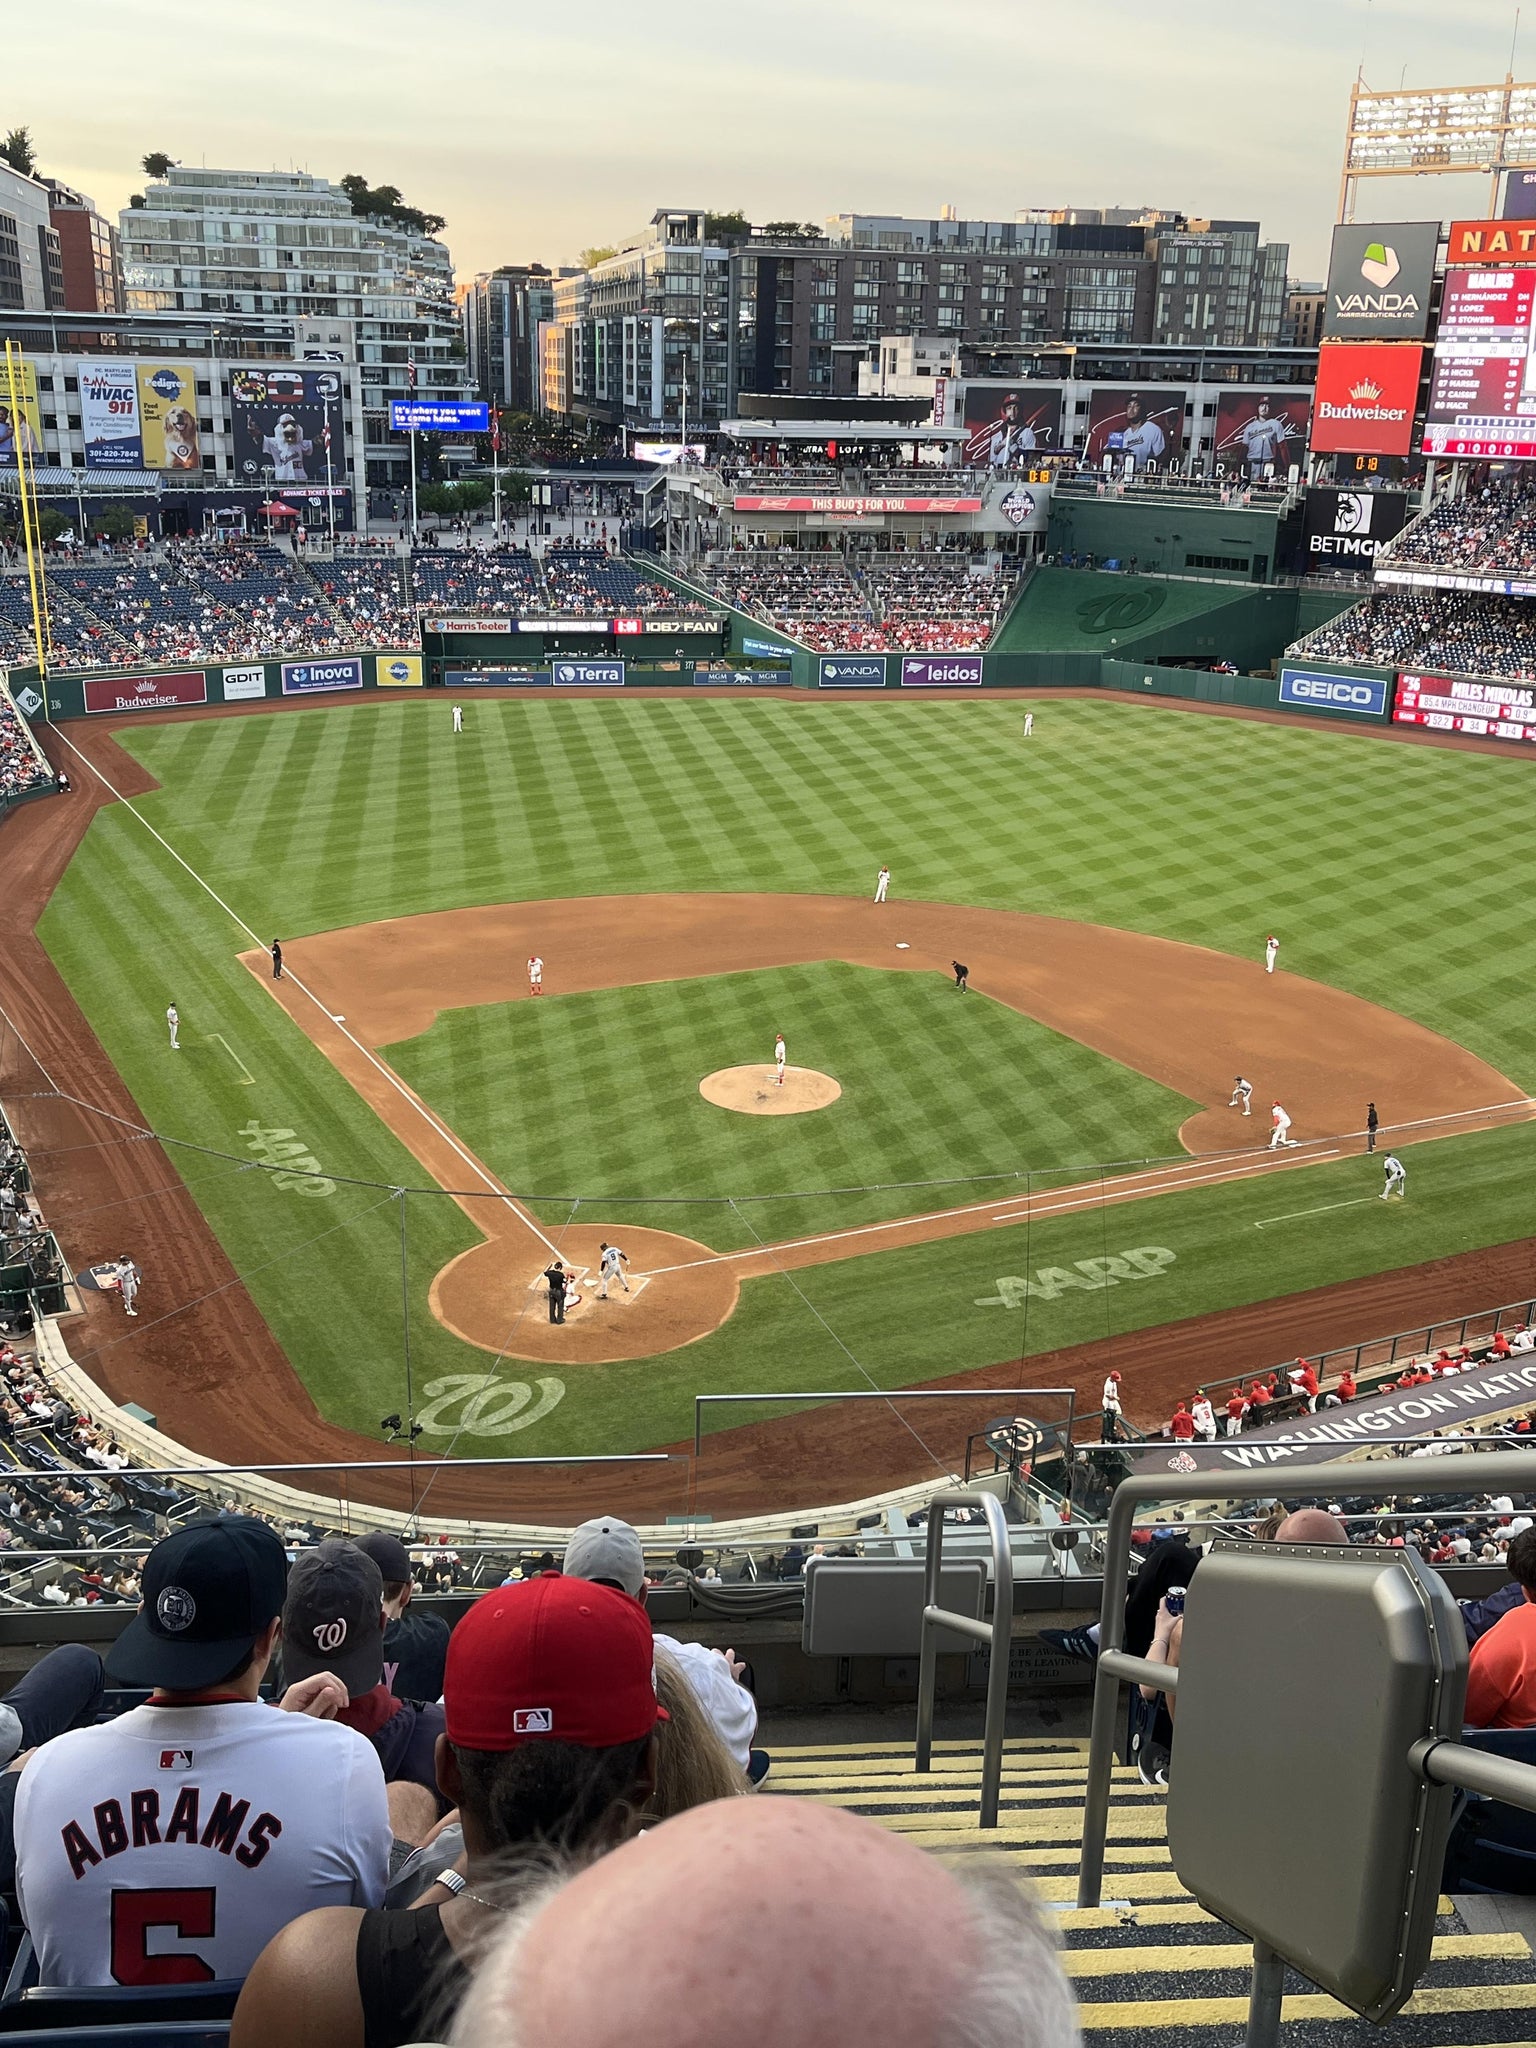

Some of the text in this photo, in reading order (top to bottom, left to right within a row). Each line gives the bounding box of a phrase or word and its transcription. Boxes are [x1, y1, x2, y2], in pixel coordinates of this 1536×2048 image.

[1462, 230, 1536, 252] NAT
[1335, 294, 1419, 311] VANDA
[1461, 292, 1508, 301] HERNÁNDEZ
[1459, 304, 1484, 312] LOPEZ
[1457, 315, 1495, 324] STOWERS
[1451, 369, 1474, 377] HICKS
[144, 377, 187, 389] Pedigree
[90, 388, 134, 401] HVAC
[108, 401, 134, 414] 911
[395, 406, 481, 420] It's where you want
[1319, 402, 1406, 421] Budweiser
[395, 414, 404, 422] to
[433, 414, 460, 423] home.
[1459, 429, 1531, 440] 0 0 0 0 4
[1457, 443, 1513, 454] 0 0 0 0
[811, 499, 907, 510] THIS BUD'S FOR YOU.
[446, 622, 508, 631] Harris Teeter
[683, 623, 718, 632] FAN
[310, 666, 353, 681] Inova
[576, 667, 619, 681] Terra
[837, 667, 881, 675] VANDA
[928, 665, 979, 681] leidos
[225, 672, 263, 684] GDIT
[1292, 679, 1372, 705] GEICO
[1451, 681, 1533, 708] MILES MIKOLAS
[115, 694, 178, 709] Budweiser
[1441, 699, 1457, 709] MPH
[1457, 701, 1496, 715] CHANGEUP
[1432, 715, 1449, 726] 52.2
[1469, 721, 1480, 730] 34
[239, 1119, 337, 1197] AARP
[976, 1246, 1177, 1309] AARP
[1203, 1410, 1210, 1420] 9
[1221, 1392, 1459, 1468] WASHINGTON
[1033, 1658, 1079, 1667] LEAVING
[1008, 1669, 1060, 1679] HE FIELD
[61, 1786, 283, 1880] ABRAMS
